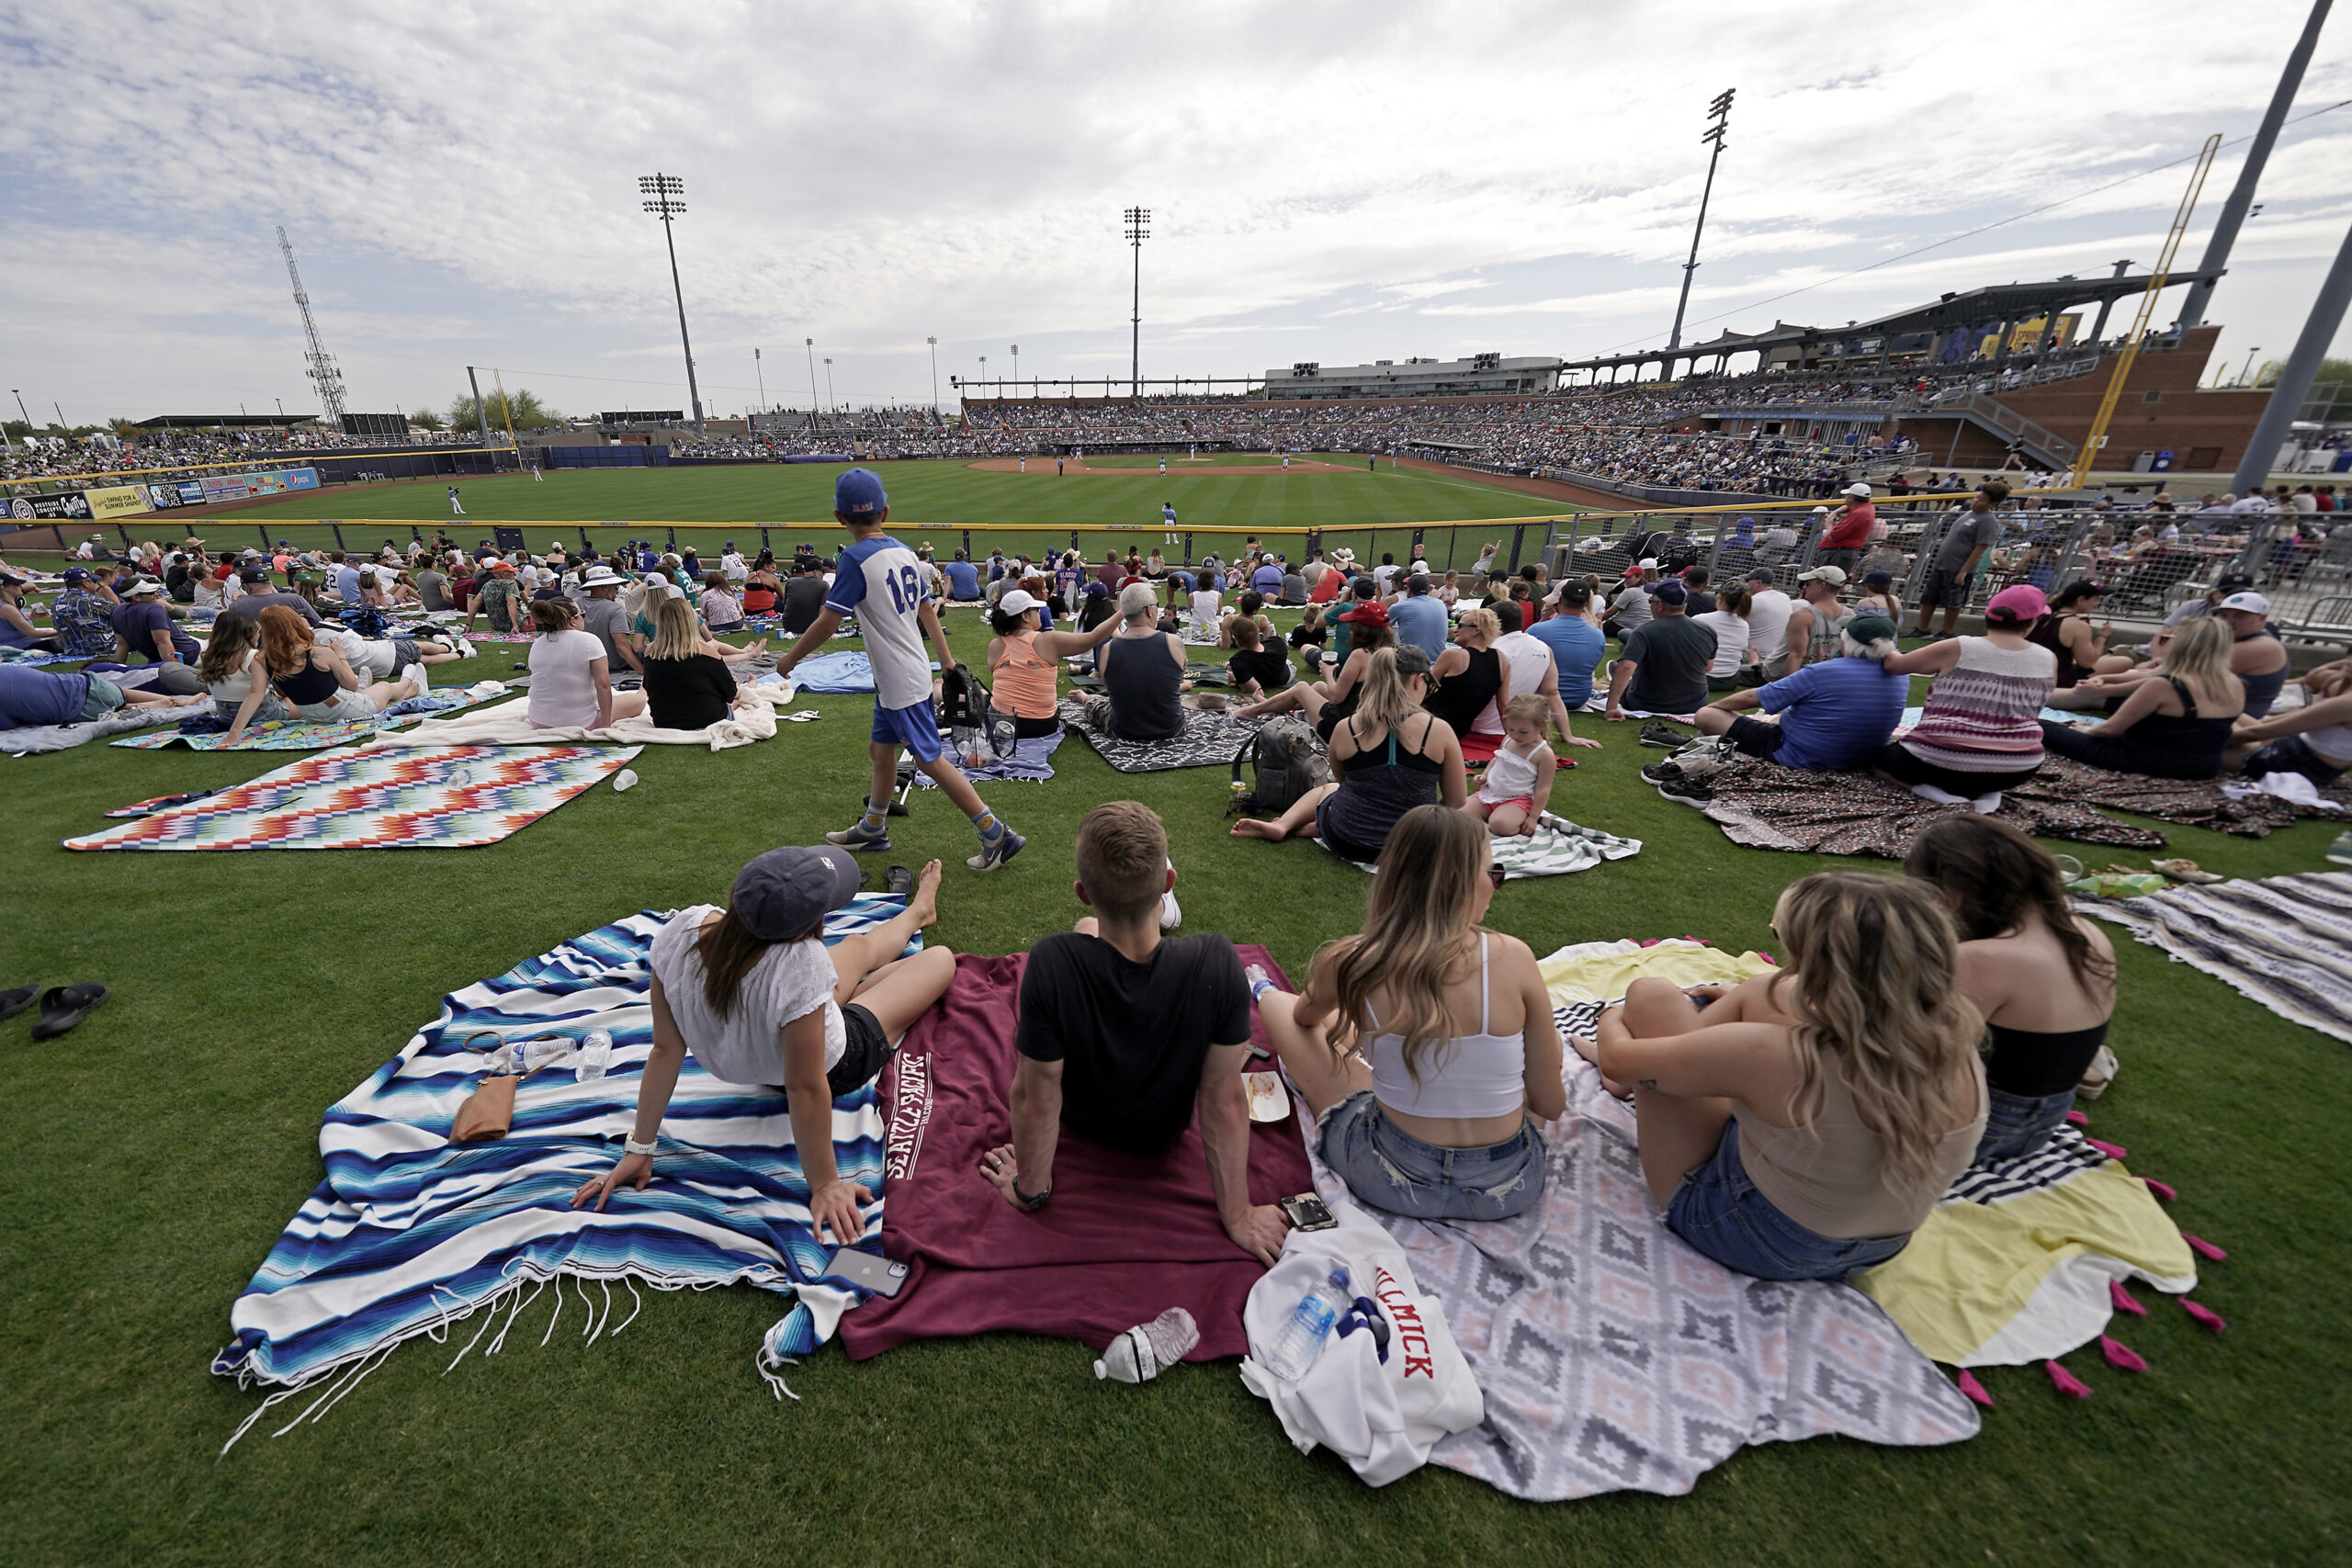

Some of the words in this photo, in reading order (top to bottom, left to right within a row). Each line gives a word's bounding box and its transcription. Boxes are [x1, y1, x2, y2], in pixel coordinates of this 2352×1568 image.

[297, 476, 310, 484] pepsi
[159, 483, 179, 492] PEORIA
[107, 495, 123, 503] SWING
[166, 491, 178, 499] THE
[105, 502, 124, 510] SUMMER
[164, 498, 182, 507] PLACE
[732, 559, 742, 568] 12
[886, 565, 918, 615] 16
[899, 1053, 925, 1105] PACIFIC
[887, 1107, 922, 1179] SEATTLE
